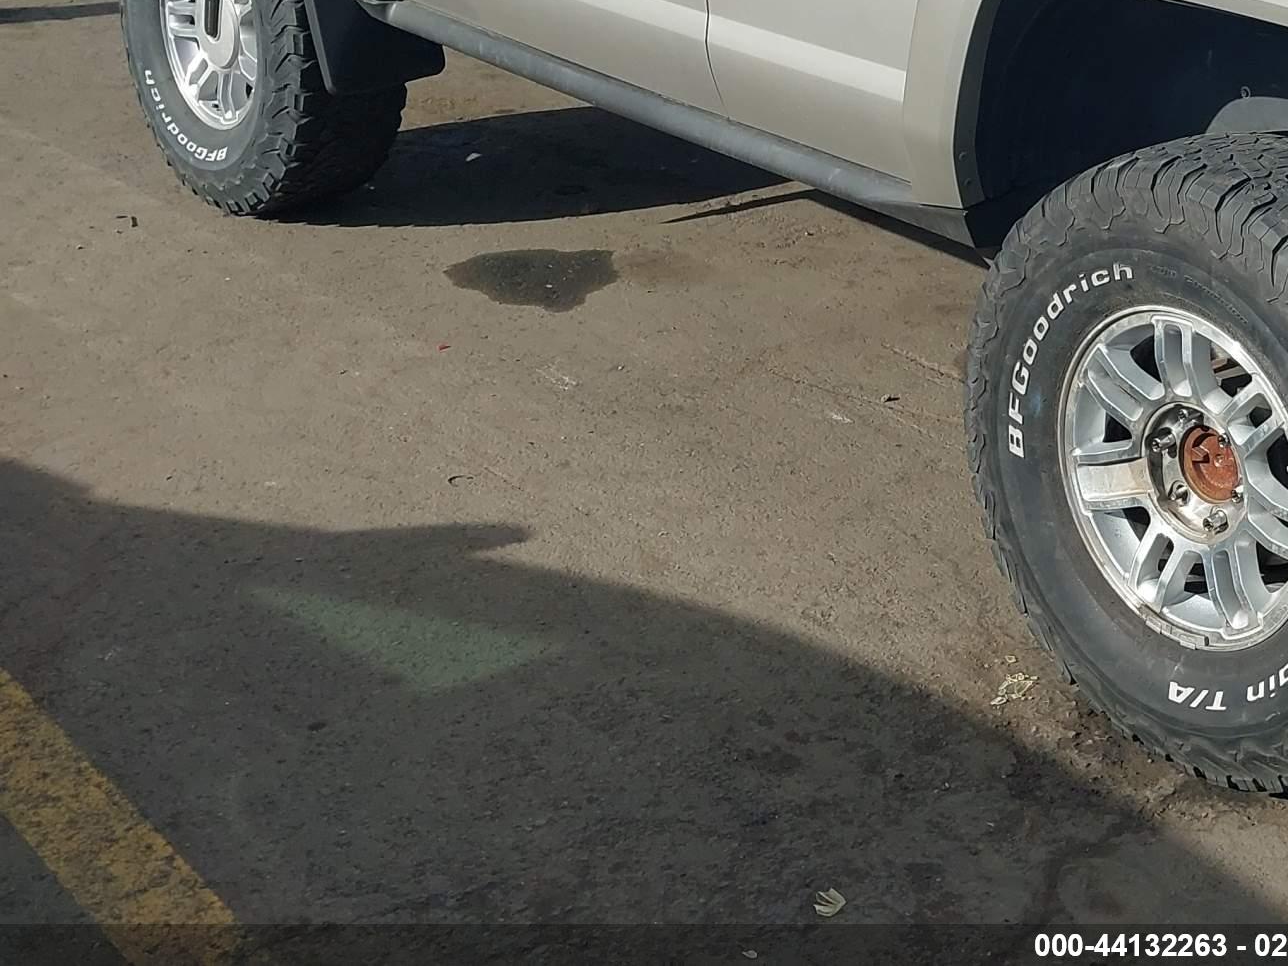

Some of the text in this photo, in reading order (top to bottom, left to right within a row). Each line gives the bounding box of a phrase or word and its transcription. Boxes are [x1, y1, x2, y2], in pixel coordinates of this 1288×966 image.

[144, 70, 228, 161] BFGoodrich
[1007, 262, 1135, 459] BFGoodrich
[1165, 680, 1229, 712] T/A
